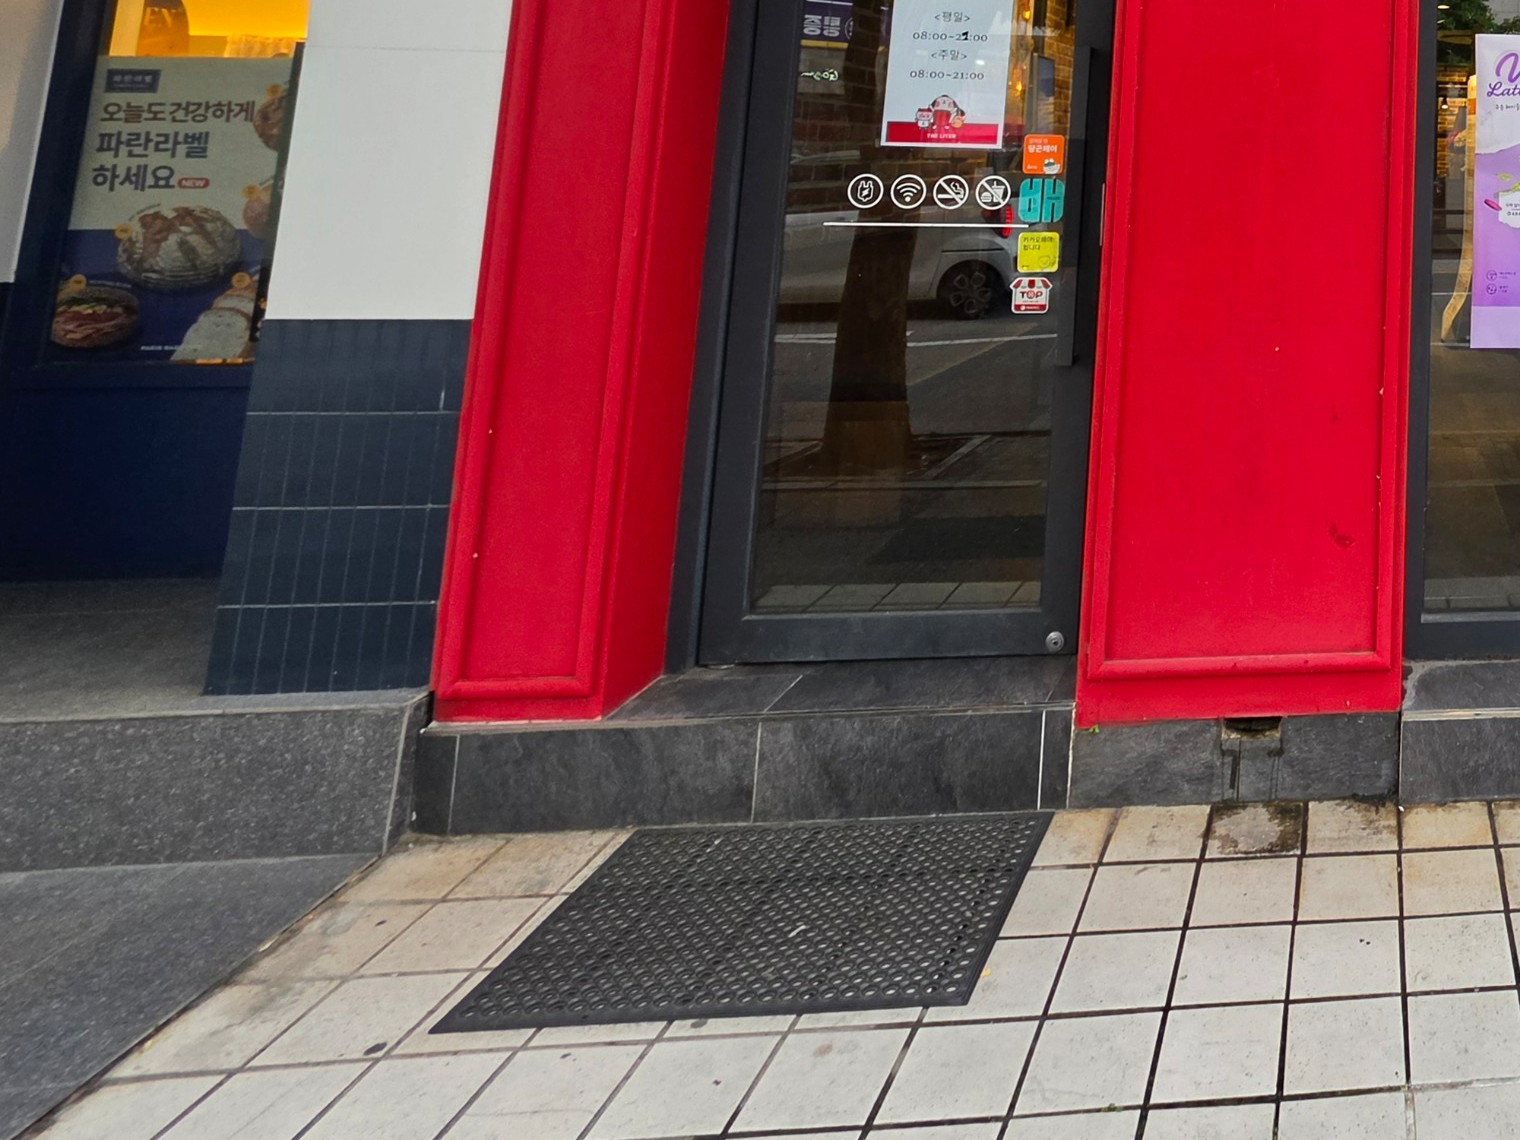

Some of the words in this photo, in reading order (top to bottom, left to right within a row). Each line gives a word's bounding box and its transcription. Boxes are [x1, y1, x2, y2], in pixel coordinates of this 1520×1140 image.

[910, 69, 984, 80] 08:00~21:00
[100, 101, 167, 124] 오늘도
[168, 100, 256, 123] 건강하게
[96, 130, 210, 159] 파란라벨
[1028, 144, 1058, 153] 당근페이
[92, 163, 175, 193] 하세요
[181, 178, 206, 188] NEW
